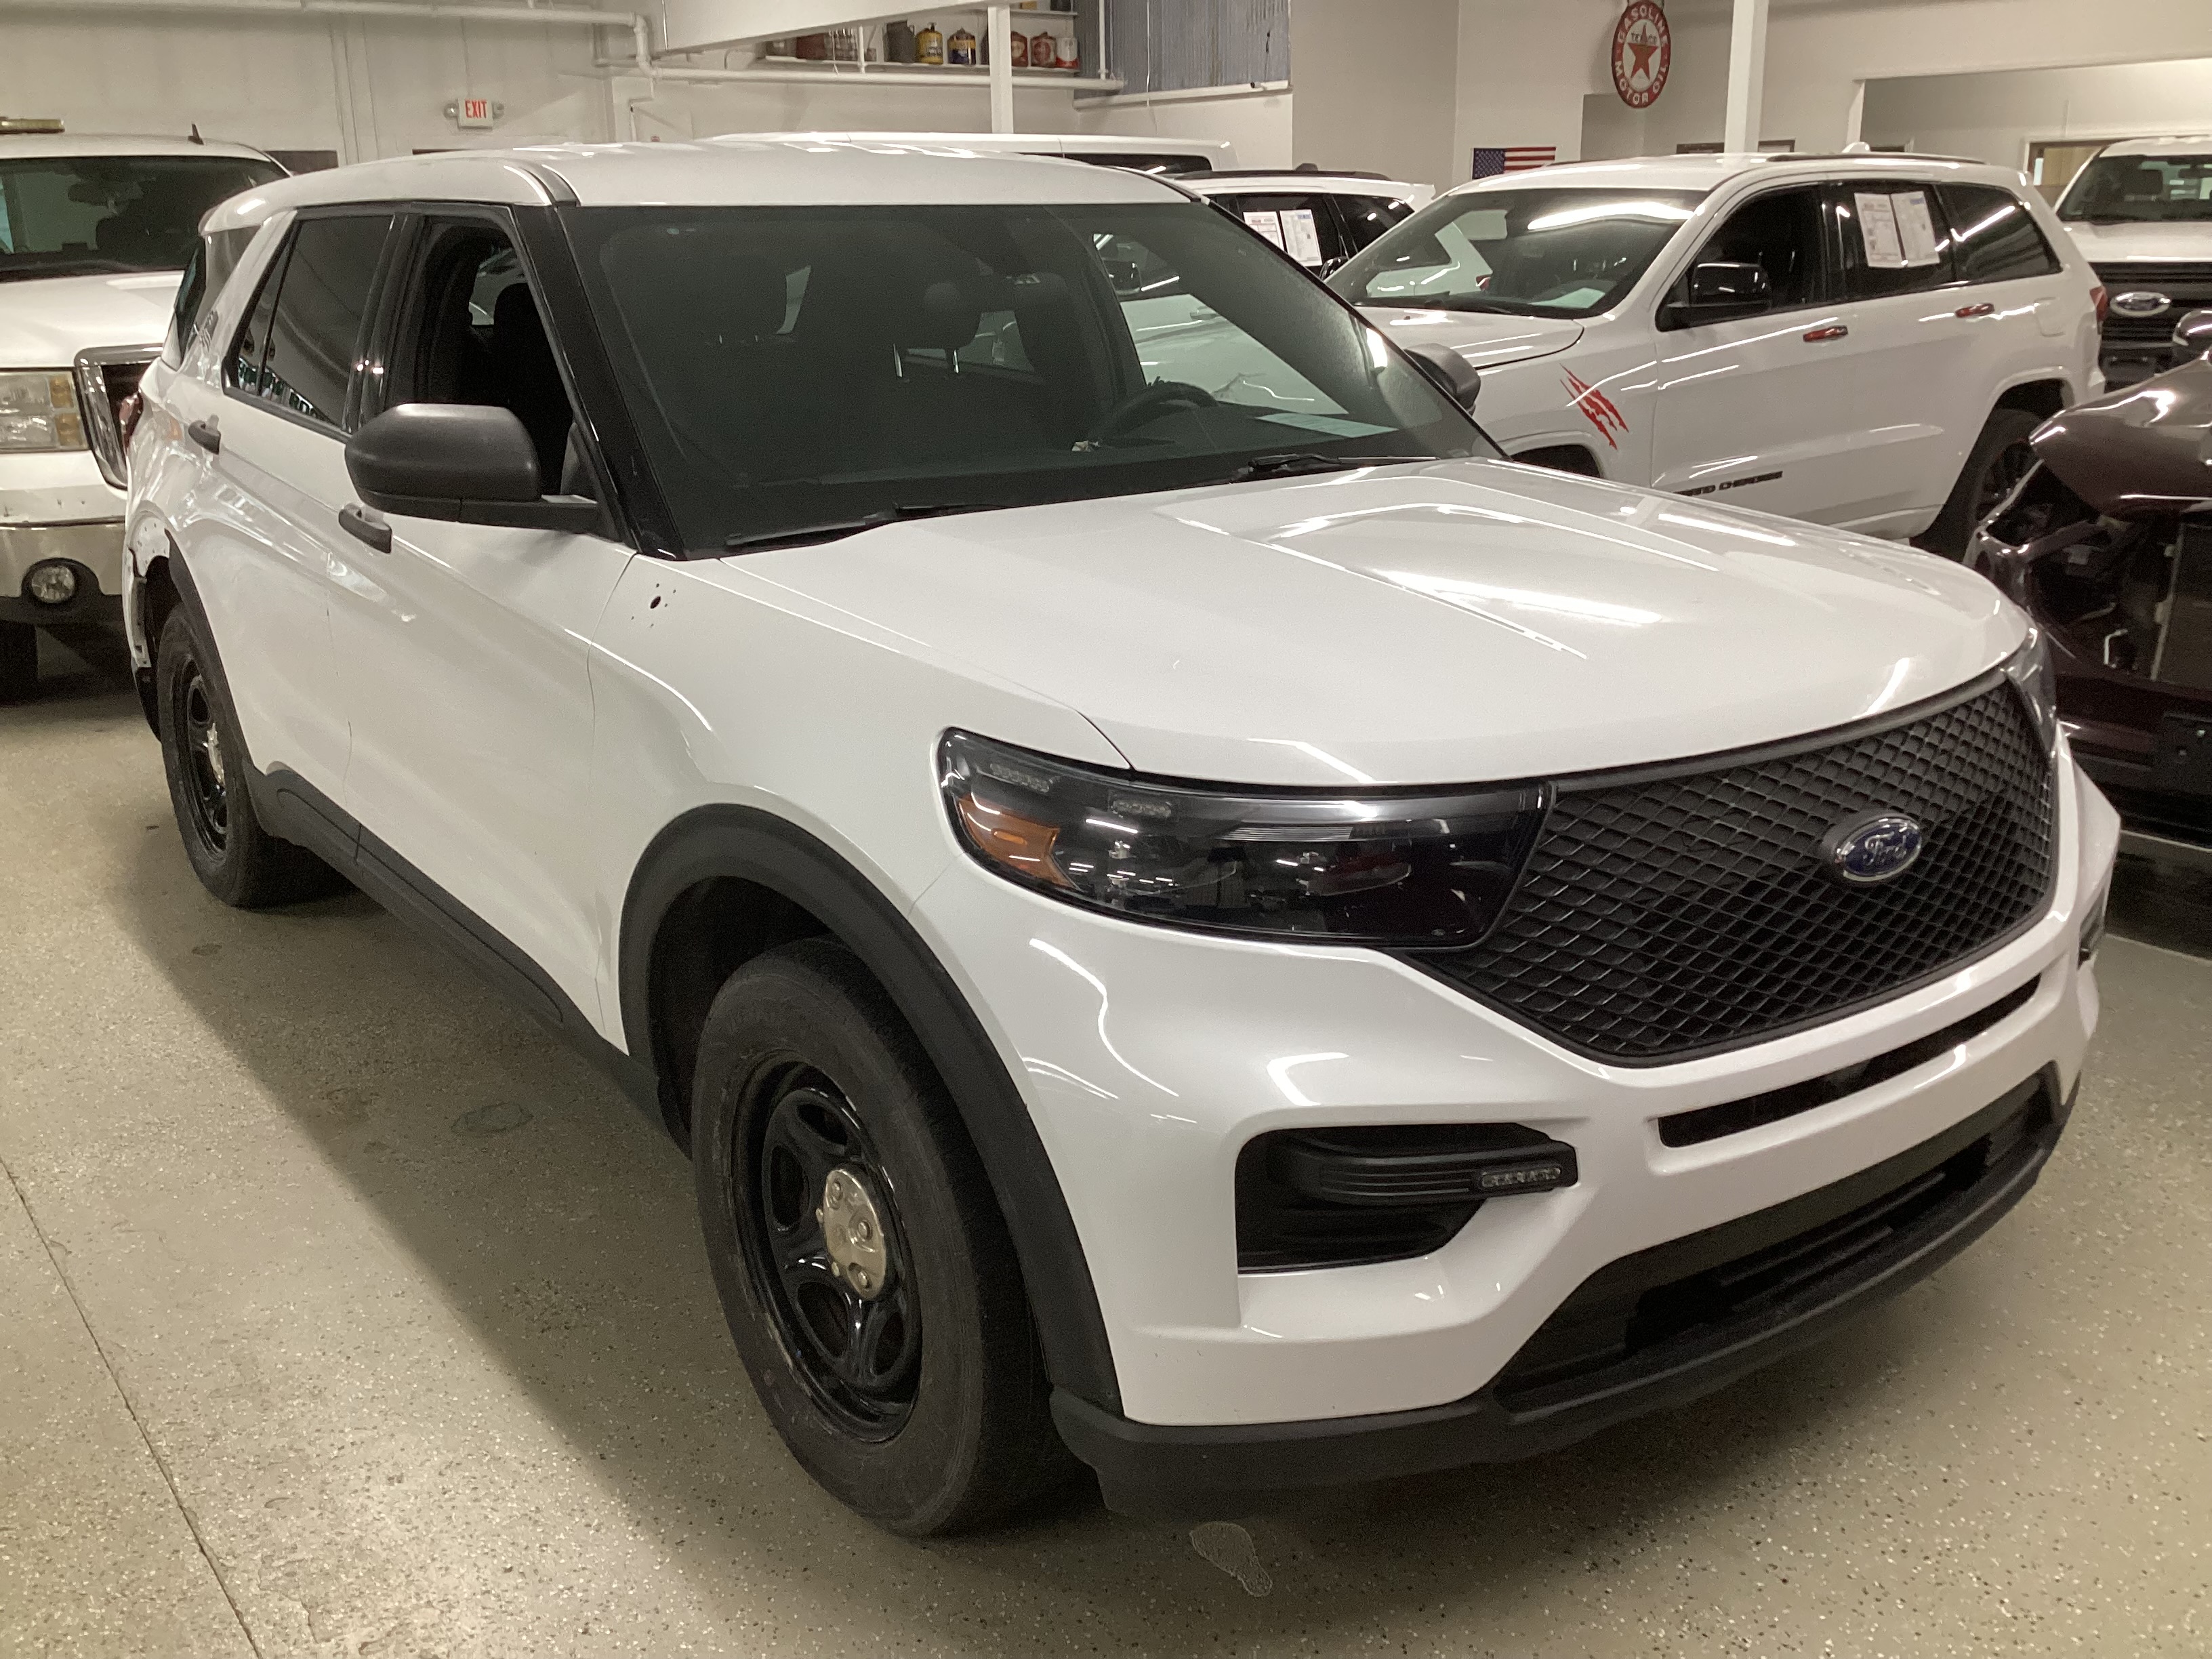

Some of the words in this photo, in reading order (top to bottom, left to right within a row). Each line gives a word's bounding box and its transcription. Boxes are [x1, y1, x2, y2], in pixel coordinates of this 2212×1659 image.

[1618, 5, 1668, 46] GASOLINE
[1615, 61, 1649, 105] MOTOR
[1653, 65, 1668, 94] OIL
[465, 100, 487, 119] EXIT
